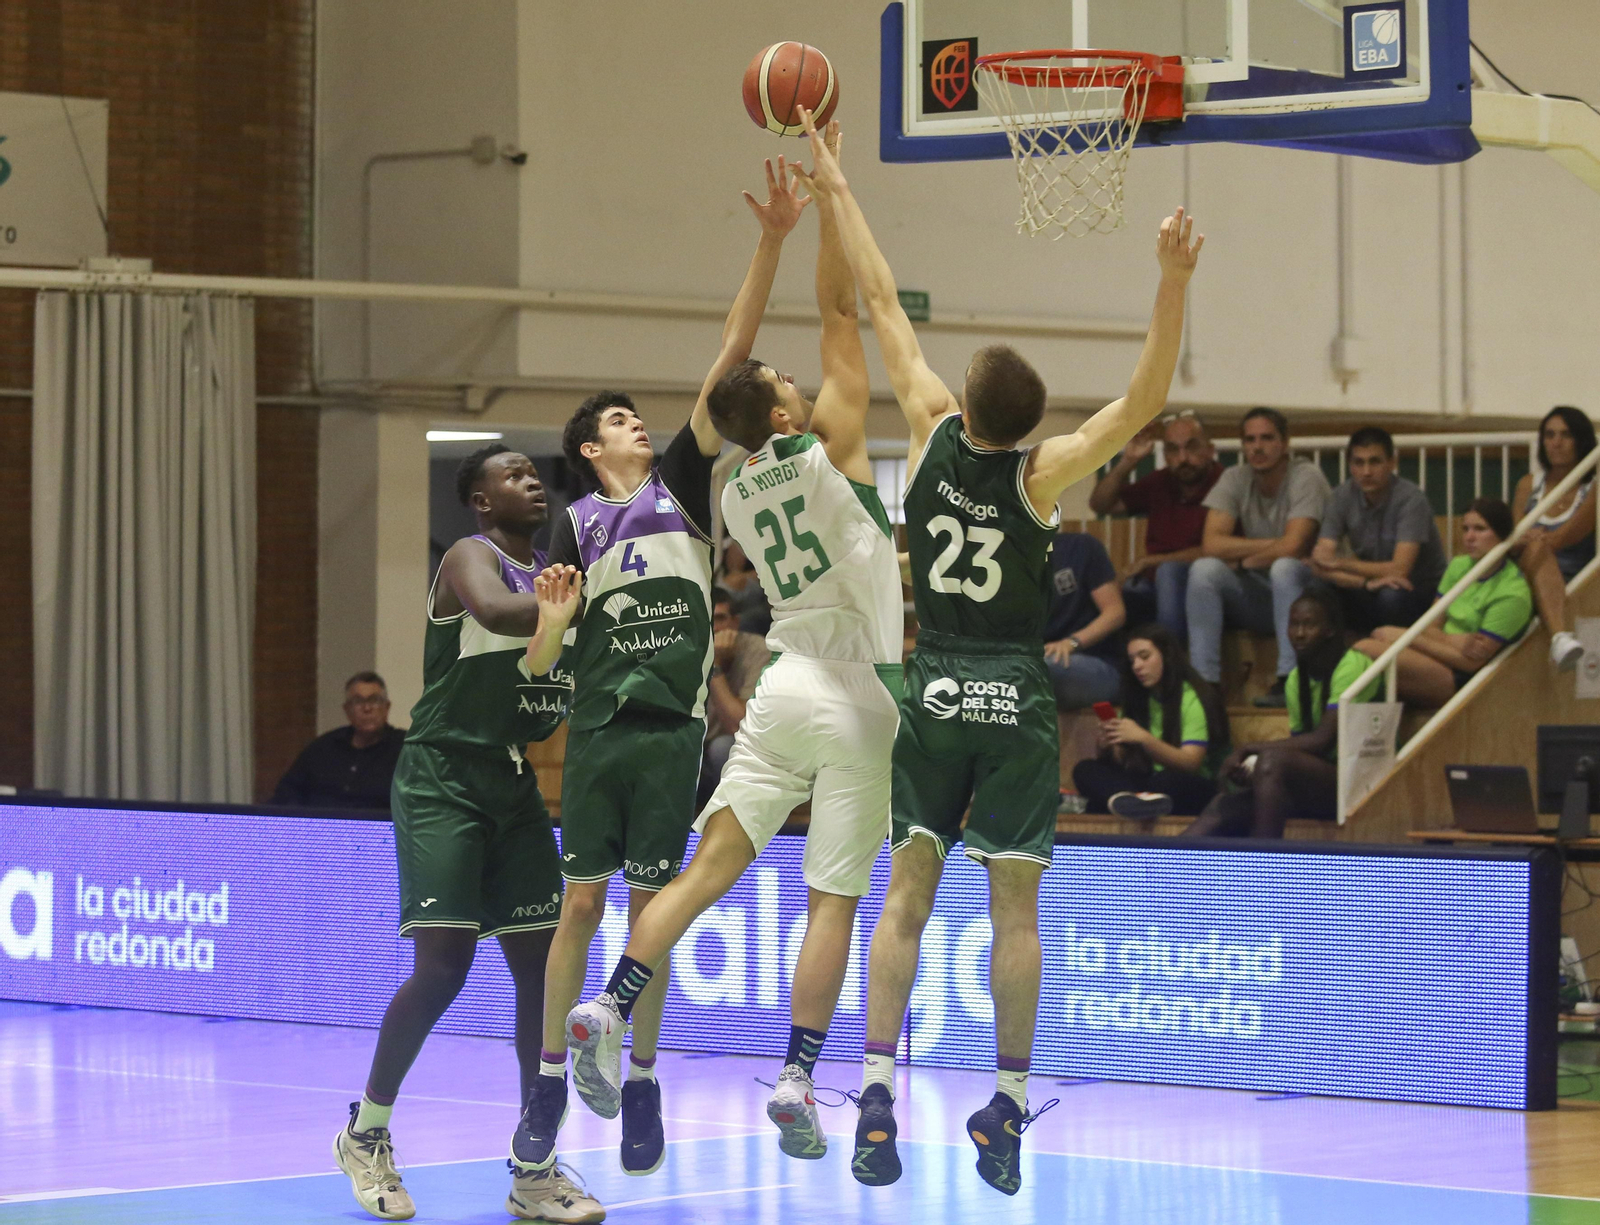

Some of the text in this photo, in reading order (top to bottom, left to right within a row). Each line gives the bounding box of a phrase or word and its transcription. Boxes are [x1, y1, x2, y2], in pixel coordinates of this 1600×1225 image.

[953, 45, 966, 53] FEB
[1358, 40, 1373, 49] LIGA
[1358, 48, 1389, 65] EBA
[736, 461, 800, 500] B. MURGI
[936, 480, 999, 521] málaga
[620, 541, 648, 577] 4
[754, 494, 833, 601] 25
[925, 514, 1005, 603] 23
[636, 598, 690, 618] Unicaja
[961, 697, 1020, 713] DEL SOL
[962, 680, 1019, 700] COSTA
[961, 709, 1019, 726] MÁLAGA
[75, 873, 229, 924] la ciudad
[75, 924, 215, 971] redonda
[1066, 922, 1282, 982] la ciudad
[1066, 983, 1261, 1038] redonda
